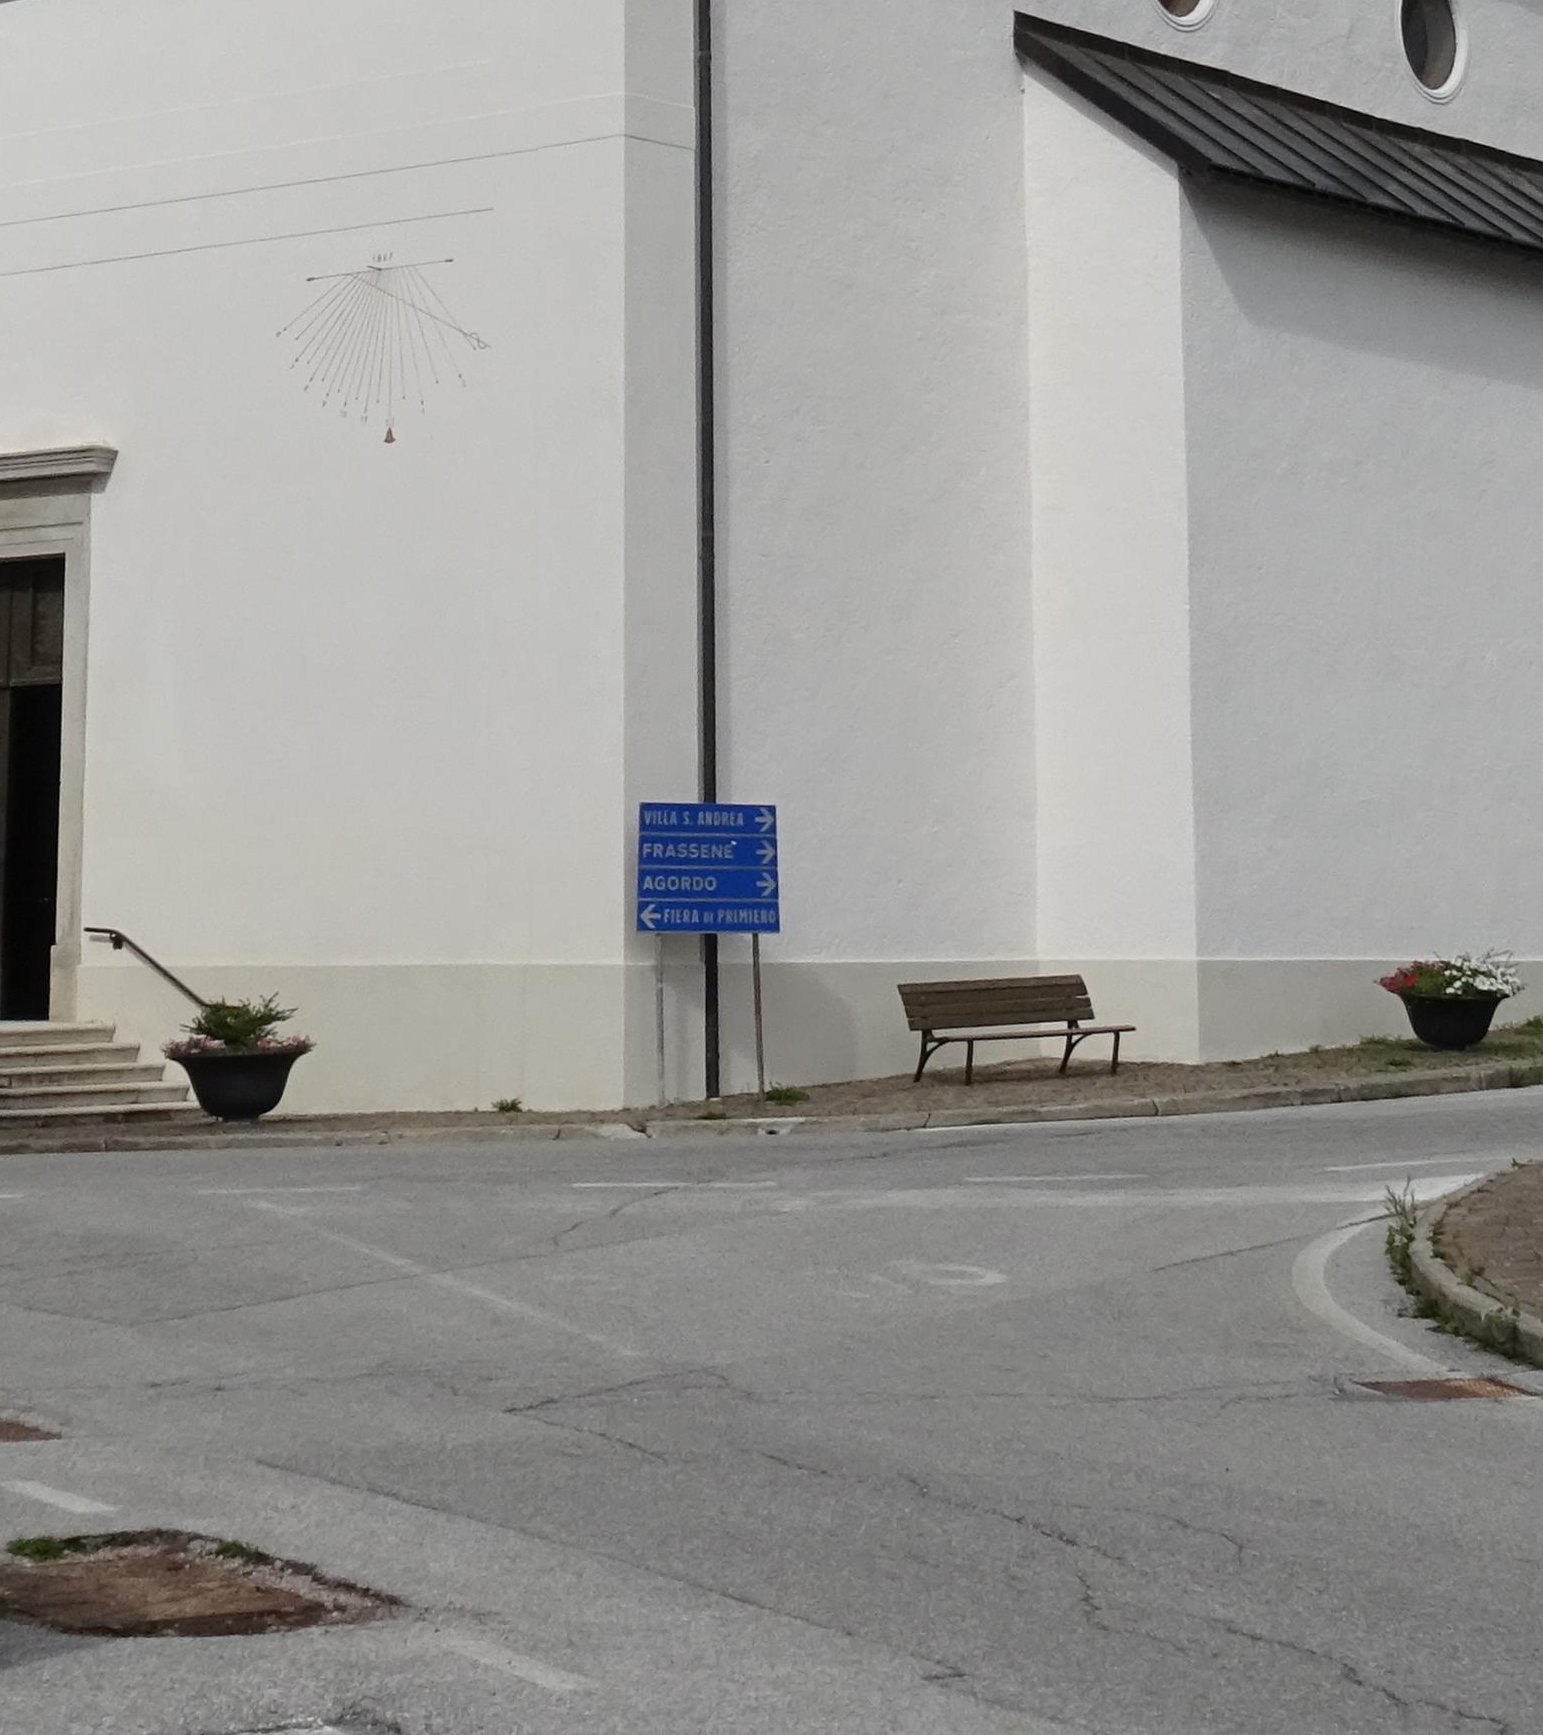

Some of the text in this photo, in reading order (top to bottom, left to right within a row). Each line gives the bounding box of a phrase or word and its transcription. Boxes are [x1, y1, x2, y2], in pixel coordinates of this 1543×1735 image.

[643, 811, 744, 827] VILLA S. ANDREA
[642, 875, 717, 891] AGORDO
[663, 908, 700, 924] FIERA
[717, 908, 776, 924] PRIMIERO
